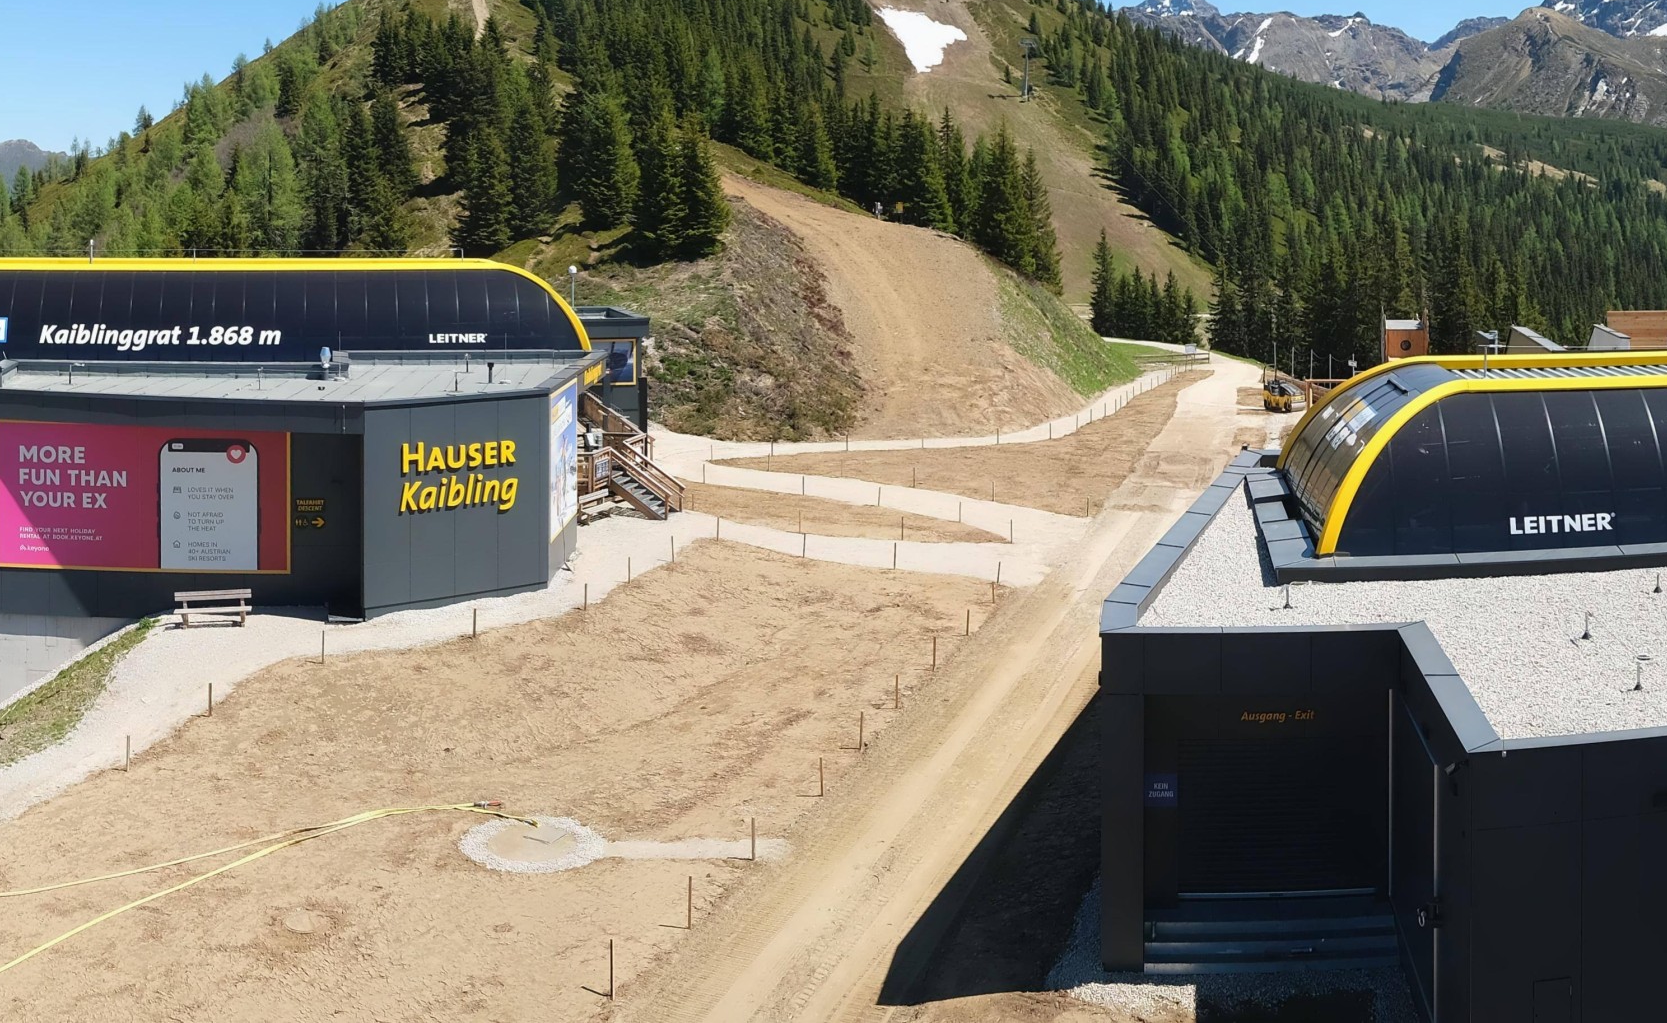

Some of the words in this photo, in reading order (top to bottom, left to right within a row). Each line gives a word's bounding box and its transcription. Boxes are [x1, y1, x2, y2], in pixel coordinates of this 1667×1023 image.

[39, 323, 181, 351] Kaiblinggrat
[186, 326, 254, 346] 1.868
[258, 329, 282, 345] m
[428, 333, 487, 344] LEITNER
[19, 445, 86, 464] MORE
[401, 440, 516, 474] HAUSER
[19, 468, 60, 486] FUN
[67, 470, 127, 487] THAN
[20, 490, 76, 508] YOUR
[82, 492, 107, 509] EX
[400, 473, 518, 512] Kaibling
[1509, 512, 1613, 535] LEITNER
[1240, 711, 1286, 724] Ausgang
[1294, 710, 1315, 721] Exit
[1153, 782, 1169, 790] KEIN
